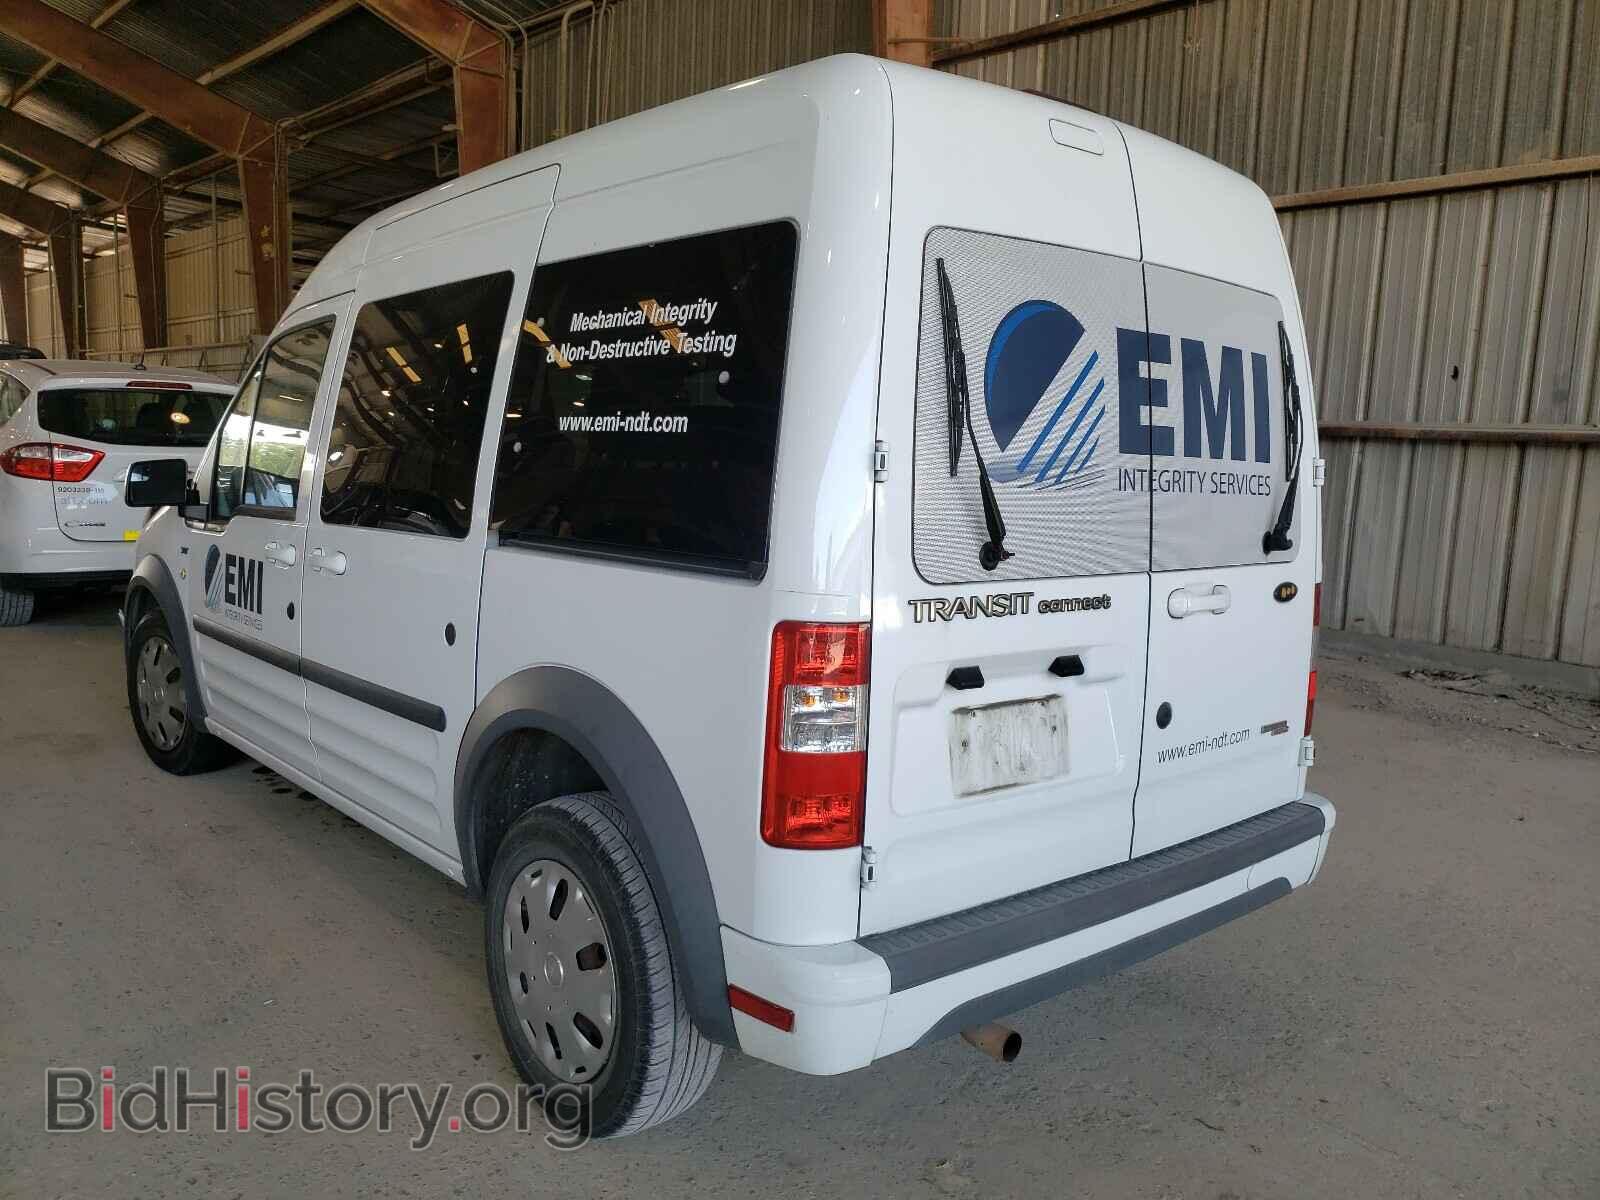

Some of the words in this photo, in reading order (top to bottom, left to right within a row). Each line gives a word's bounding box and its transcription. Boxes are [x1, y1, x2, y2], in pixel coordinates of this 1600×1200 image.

[570, 305, 648, 332] Mechanical
[650, 297, 719, 326] Integrity
[546, 344, 556, 363] &
[559, 335, 671, 362] Non-Destructive
[677, 329, 737, 358] Testing
[1116, 327, 1271, 464] EMI
[559, 411, 688, 433] www.emi-ndt.com
[1118, 467, 1207, 493] INTEGRITY
[1210, 471, 1271, 496] SERVICES
[225, 553, 264, 614] EMI
[908, 592, 1035, 623] TRANSIT
[1038, 593, 1112, 615] connect
[1157, 728, 1250, 764] www.emi-ndt.com
